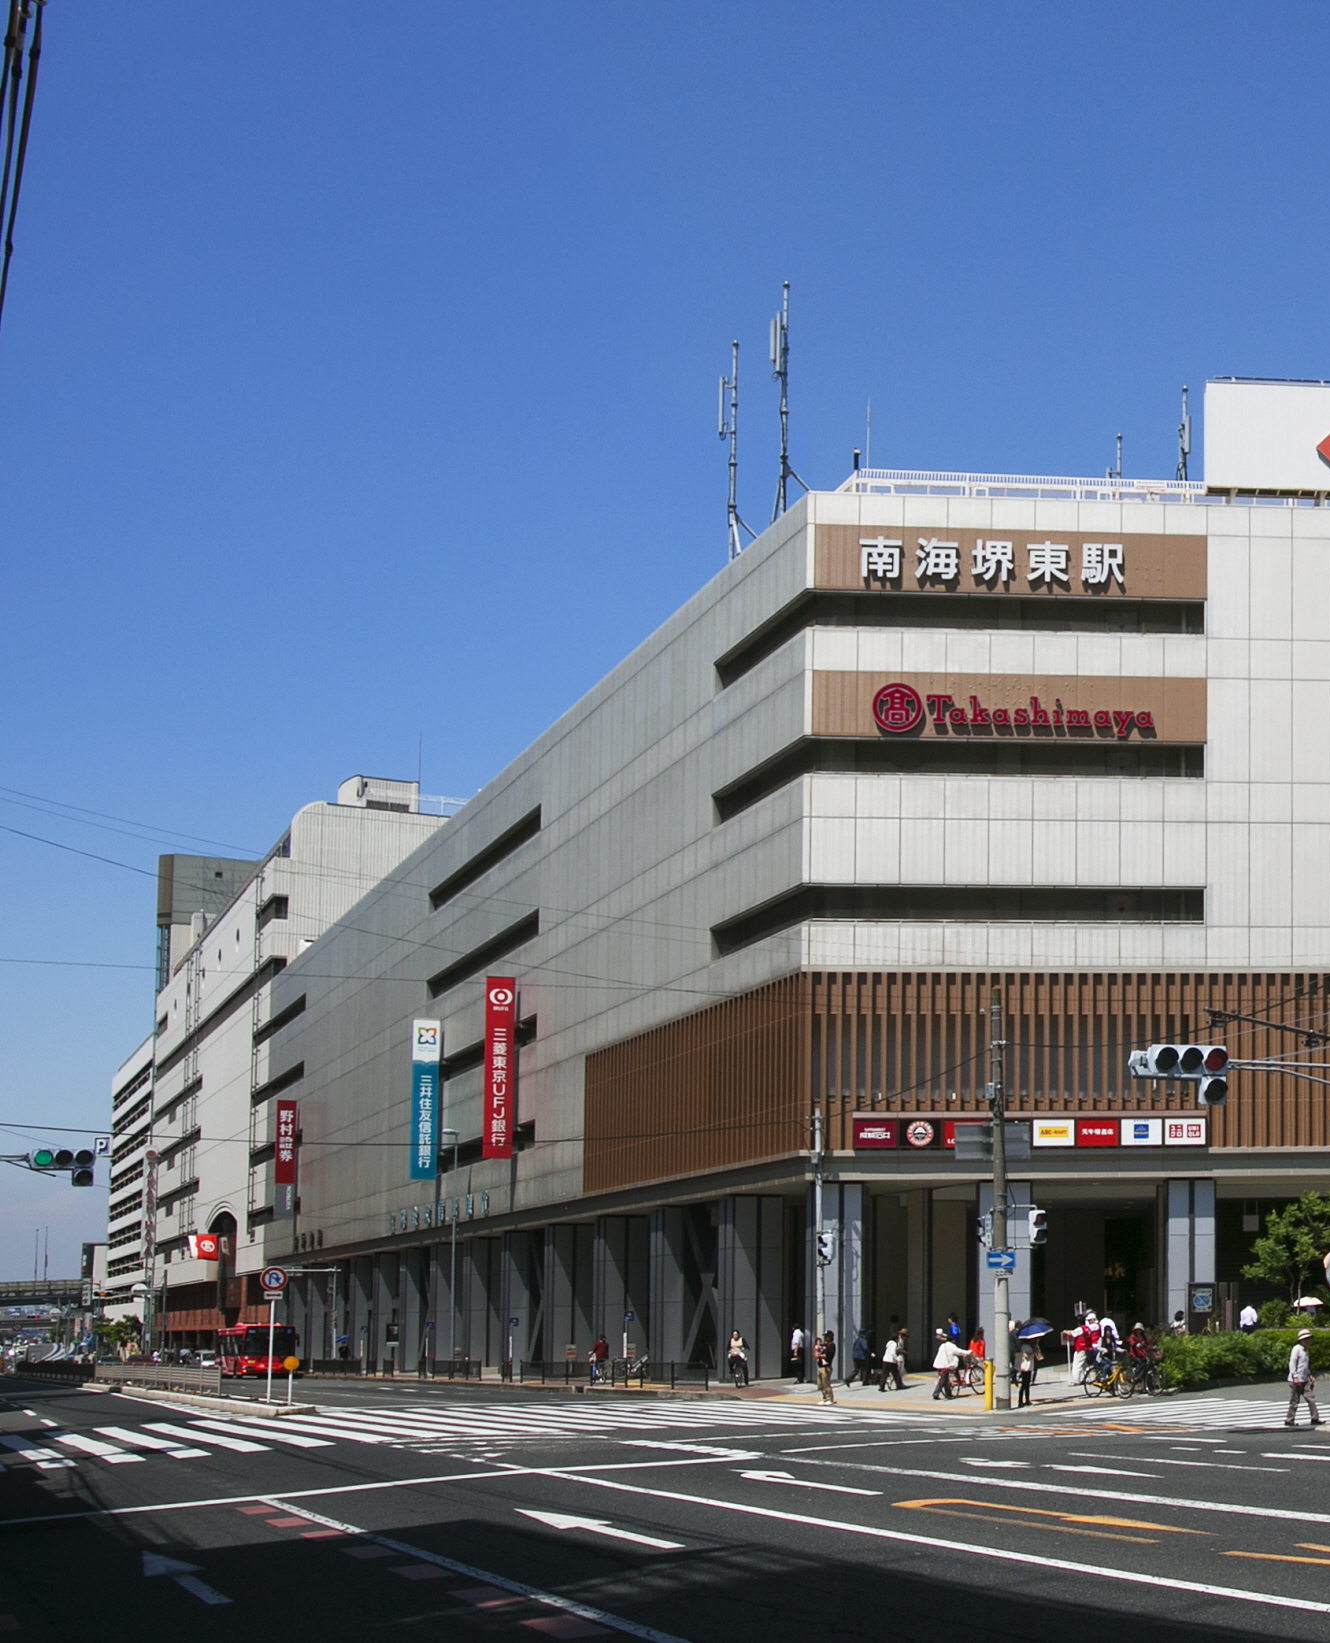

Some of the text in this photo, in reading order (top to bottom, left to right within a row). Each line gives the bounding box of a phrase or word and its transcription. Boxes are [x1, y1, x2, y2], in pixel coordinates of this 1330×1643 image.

[858, 535, 1126, 585] 南海堺東駅
[926, 693, 1154, 737] Takashimaya
[491, 1027, 508, 1147] 三菱東京UFJ銀行
[97, 1140, 107, 1153] P
[418, 1074, 433, 1169] 三井住友信託銀行
